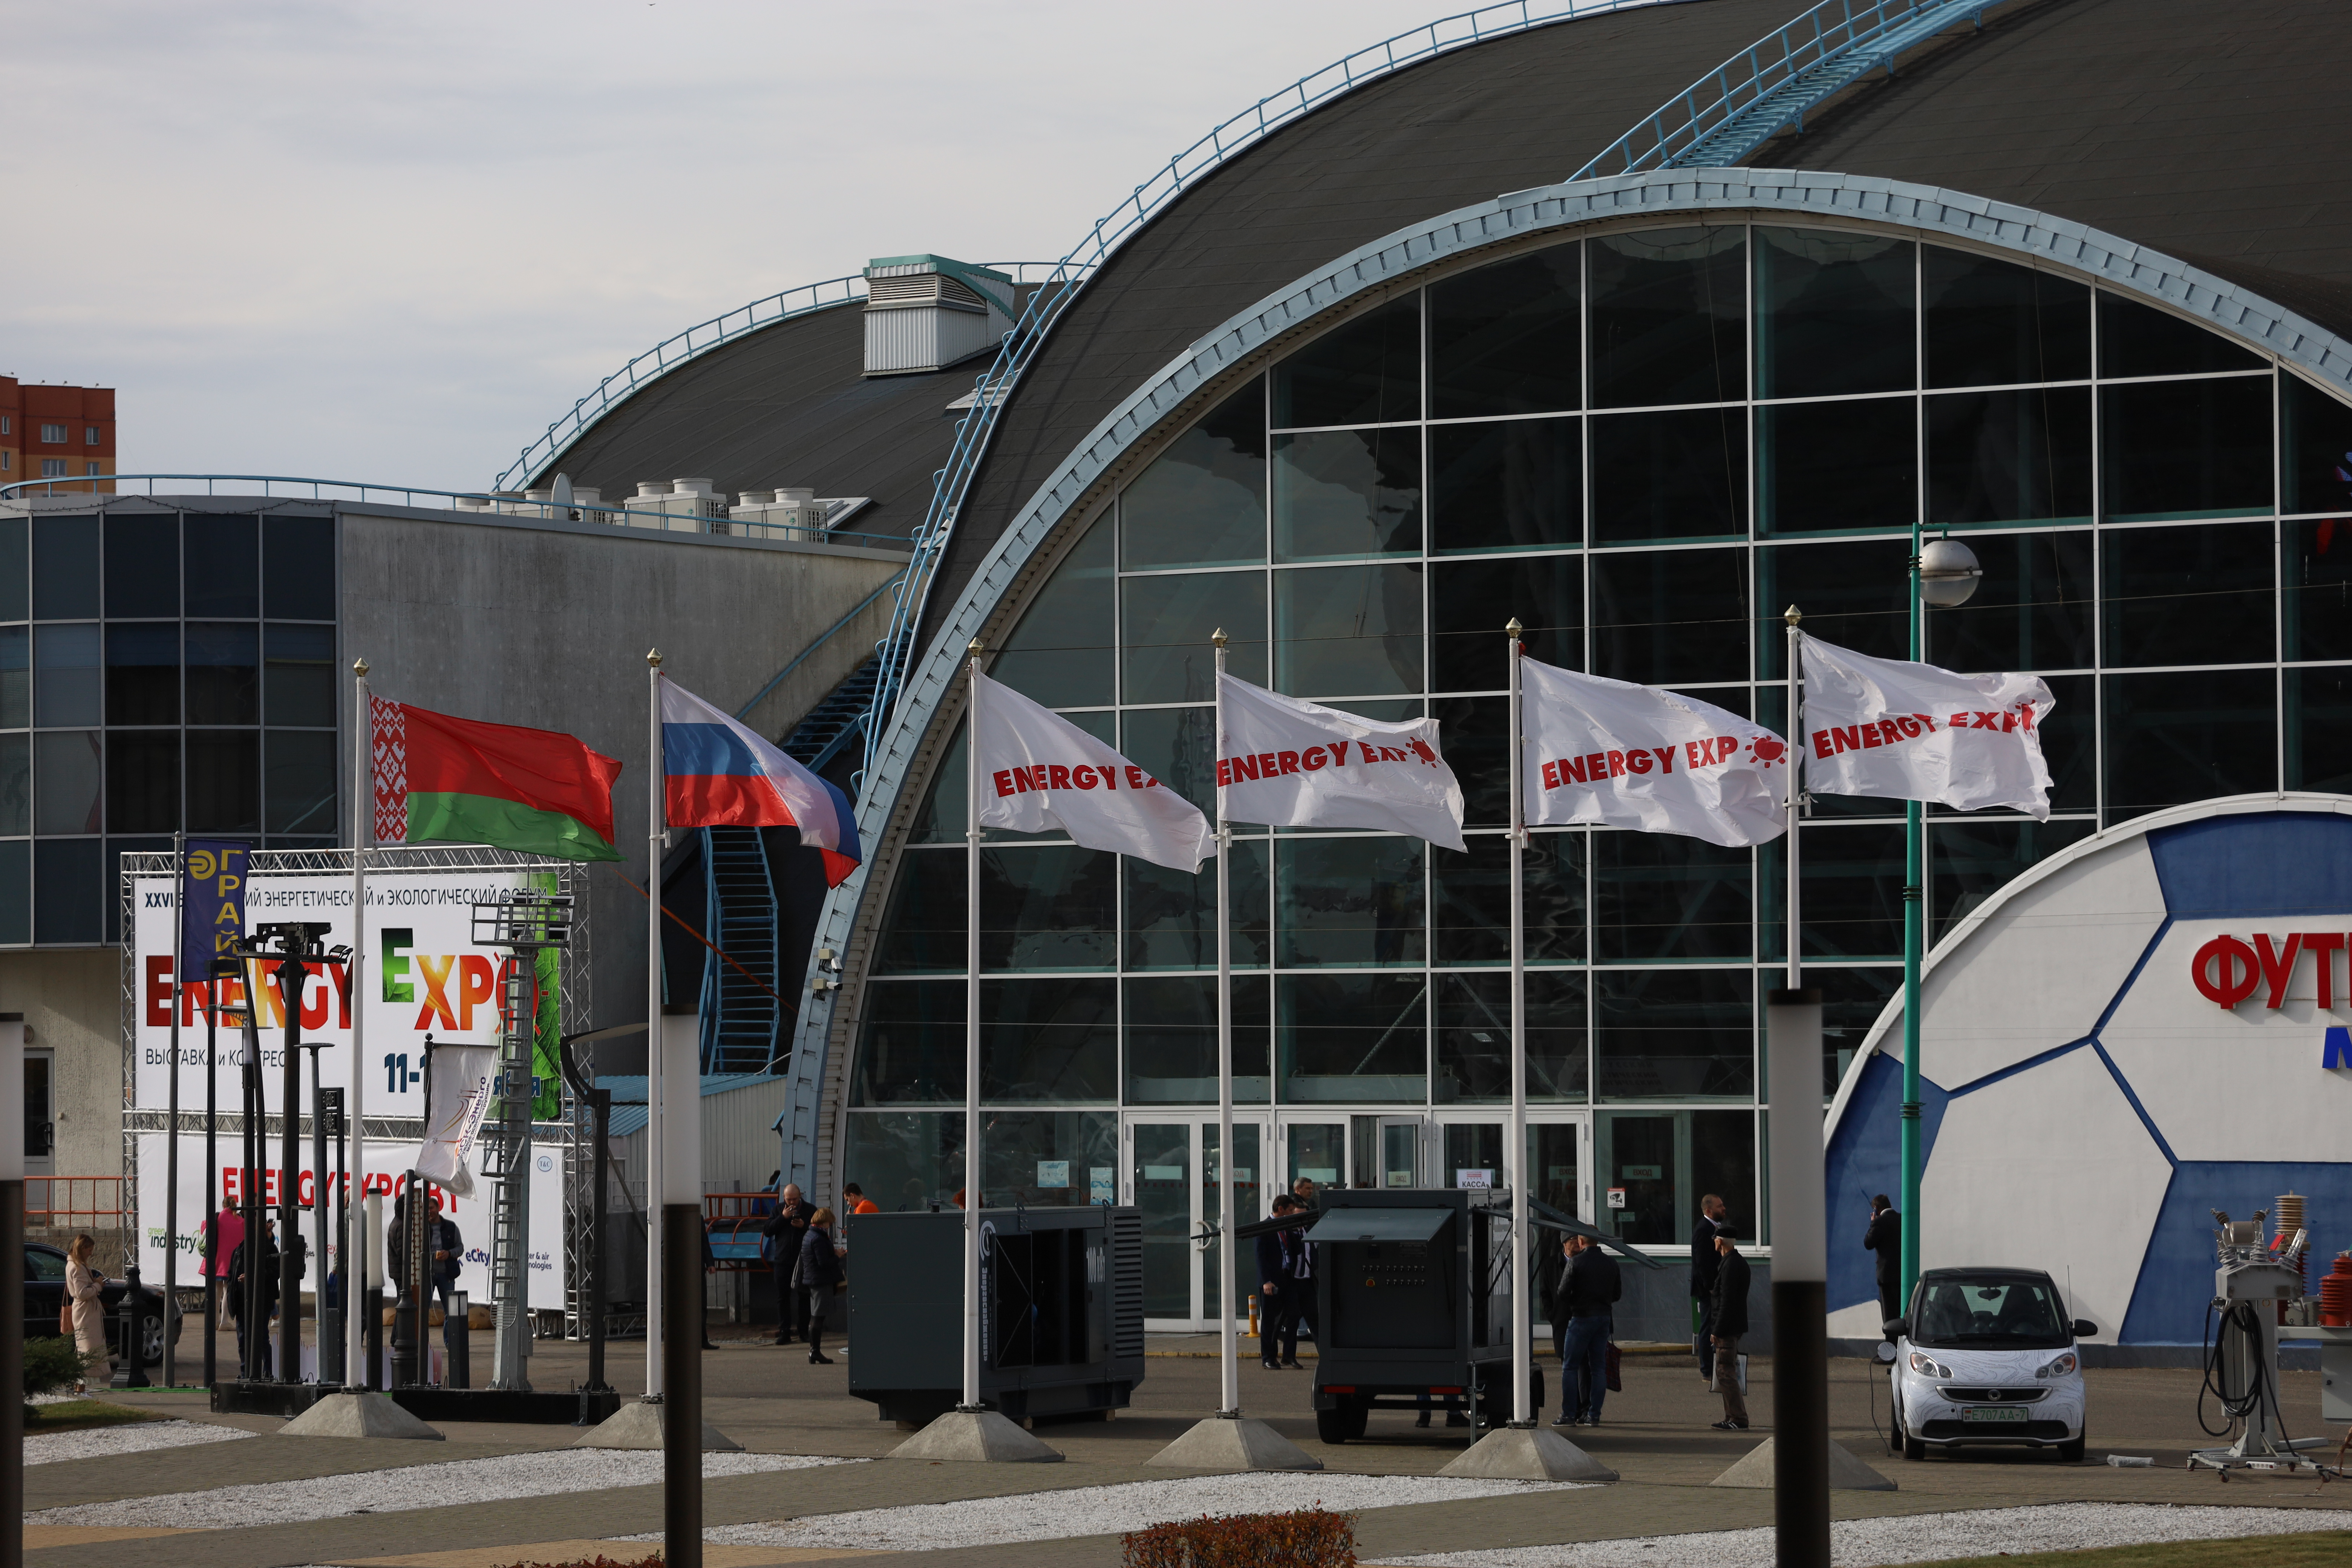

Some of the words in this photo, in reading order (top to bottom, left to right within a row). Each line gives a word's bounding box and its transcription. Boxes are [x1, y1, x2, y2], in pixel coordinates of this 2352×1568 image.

[1811, 714, 1936, 760] ENERGY
[1216, 741, 1349, 787] ENERGY
[1542, 746, 1676, 790] ENERGY
[993, 765, 1116, 798] ENERGY
[265, 886, 374, 906] ЭНЕРГЕТИЧЕСКЙ
[377, 894, 384, 905] и
[387, 884, 496, 905] ЭКОЛОГИЧЕСКИЙ
[213, 849, 243, 977] ГРАЙ
[2192, 933, 2352, 1009] ФУТ
[218, 1054, 225, 1066] и
[148, 1227, 165, 1237] green
[151, 1231, 197, 1254] indstry
[466, 1248, 490, 1266] eCity
[1086, 1246, 1096, 1283] 100
[1972, 1410, 2026, 1420] E707AA-7
